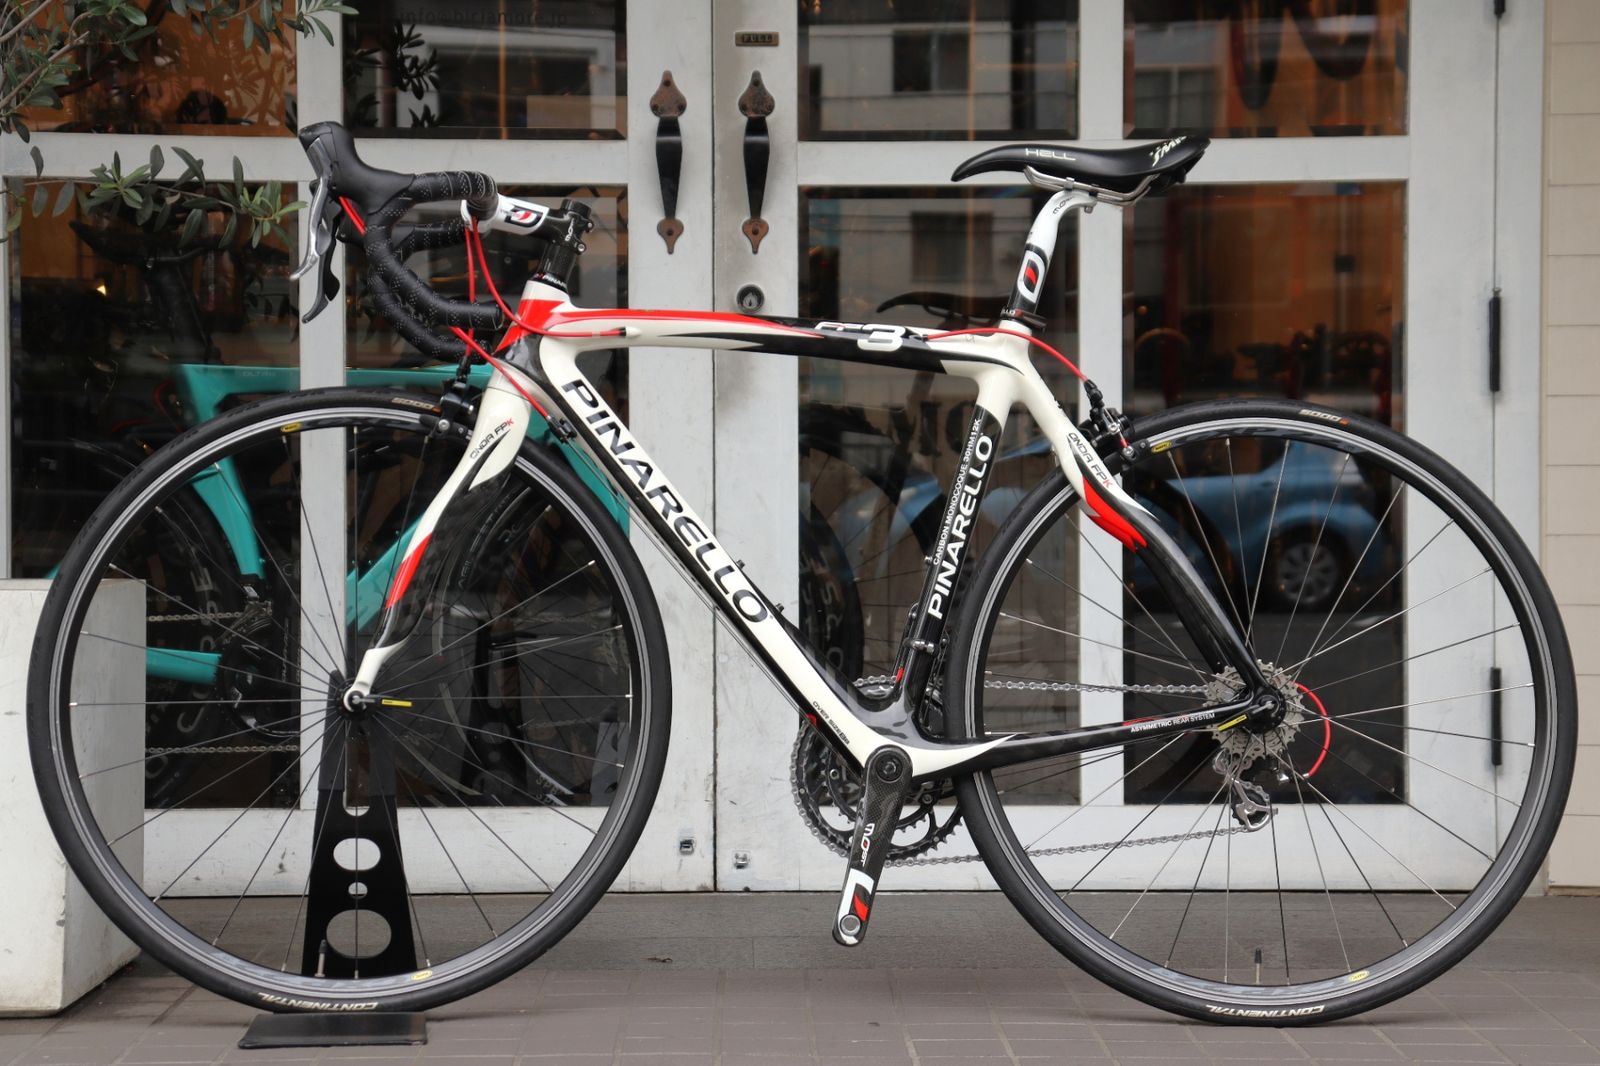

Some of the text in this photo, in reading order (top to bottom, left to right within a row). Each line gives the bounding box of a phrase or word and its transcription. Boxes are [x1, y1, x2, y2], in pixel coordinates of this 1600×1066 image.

[1068, 432, 1113, 488] ONDA FPK
[561, 379, 768, 623] PINARELLO
[927, 435, 993, 620] PINARELLO
[932, 525, 949, 565] CARBON
[947, 463, 968, 523] MONOCOQUE
[1130, 720, 1173, 733] ASYMMETRIC
[1190, 712, 1216, 723] SYSTEM
[257, 991, 379, 1011] CONTINENTAL
[1205, 1004, 1326, 1018] CONTINENTAL
